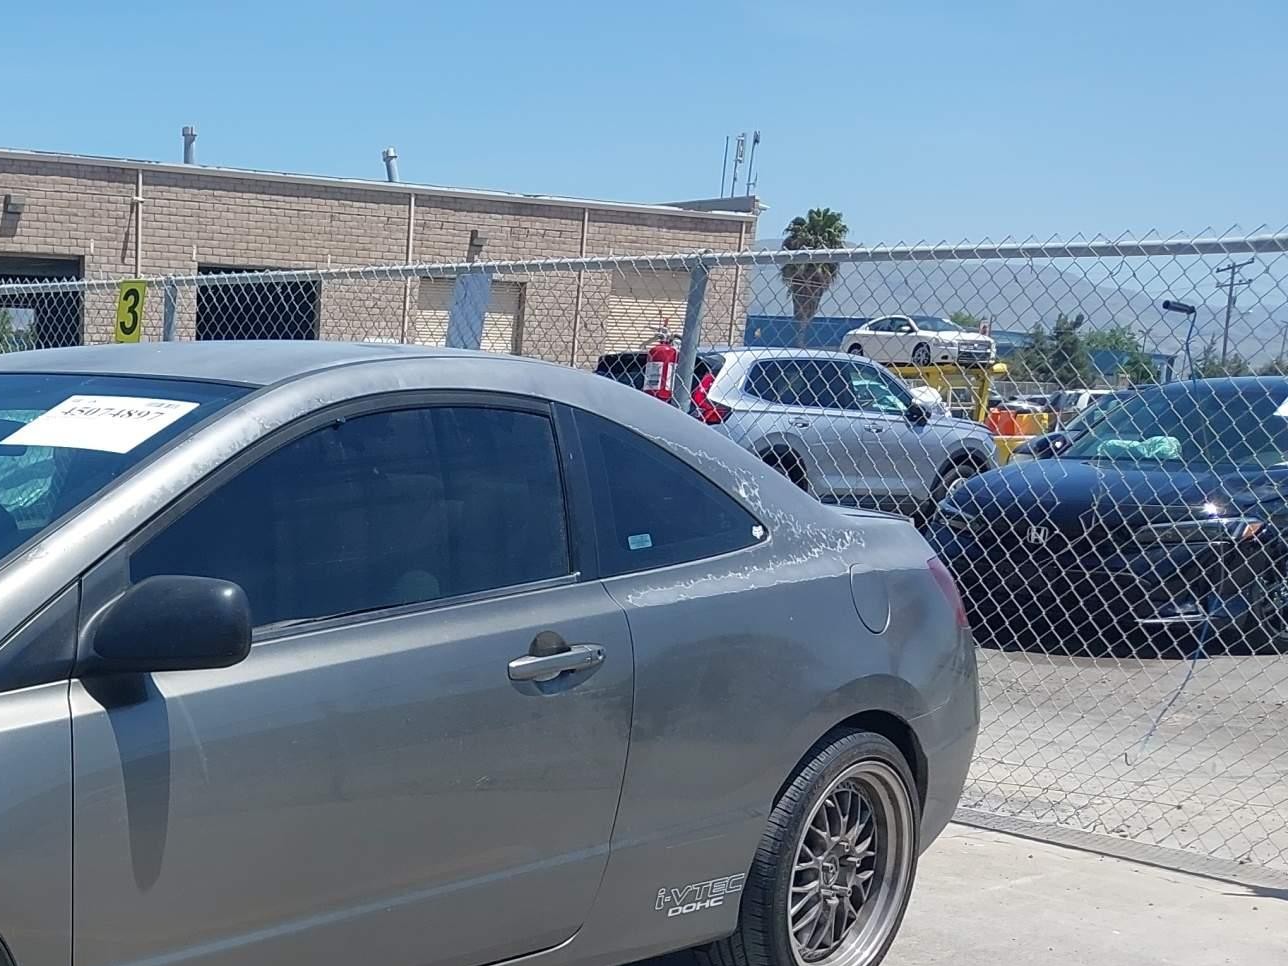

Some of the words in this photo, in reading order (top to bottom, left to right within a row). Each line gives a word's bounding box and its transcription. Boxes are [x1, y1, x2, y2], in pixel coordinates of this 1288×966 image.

[119, 287, 140, 336] 3
[655, 872, 746, 910] i-VTEC
[667, 895, 724, 917] DOHC
